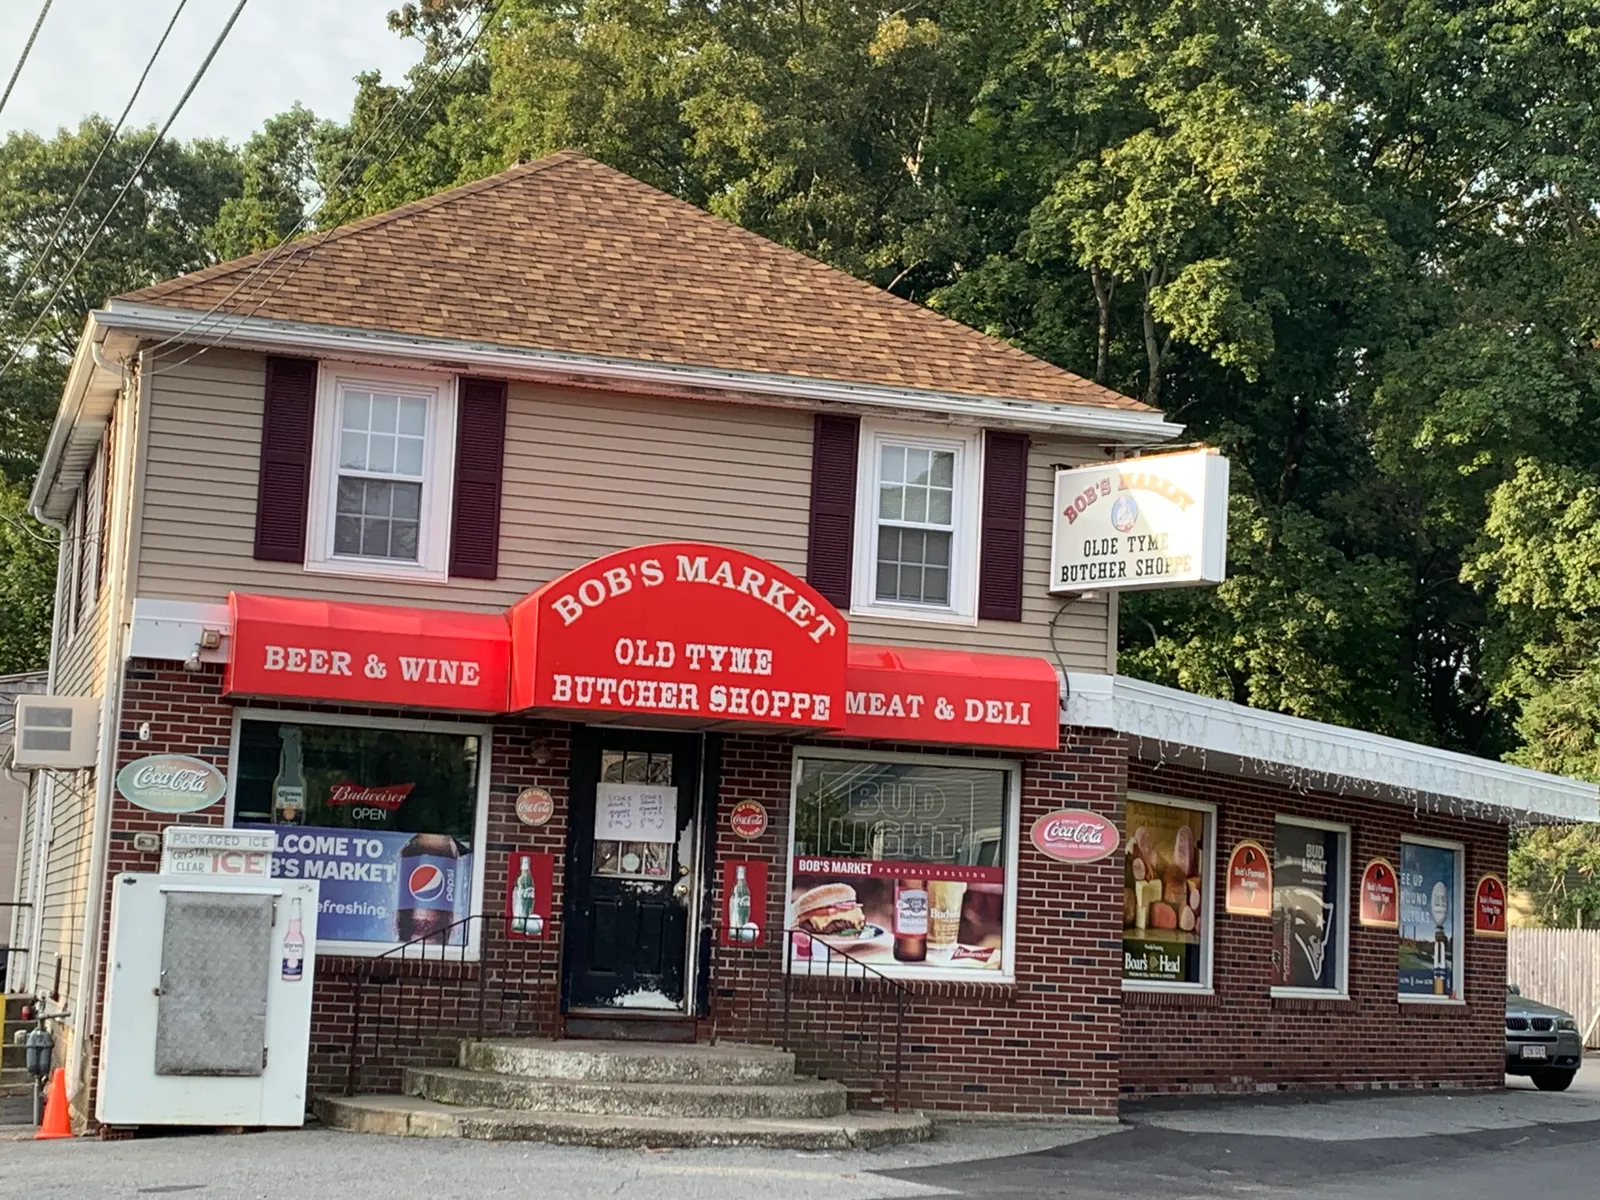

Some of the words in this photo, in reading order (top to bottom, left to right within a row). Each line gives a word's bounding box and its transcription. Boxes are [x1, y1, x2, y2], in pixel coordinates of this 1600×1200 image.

[1063, 477, 1111, 525] BOB'S
[1083, 537, 1118, 557] OLDE
[1127, 532, 1169, 553] TYME
[1061, 560, 1127, 583] BUTCHER
[1135, 554, 1192, 576] SHOPPE
[551, 559, 664, 626] BOB'S
[676, 555, 836, 644] MARKET
[263, 645, 353, 678] BEER
[364, 653, 387, 680] &
[399, 656, 481, 687] WINE
[614, 638, 676, 668] OLD
[685, 643, 773, 676] TYME
[552, 674, 700, 710] BUTCHER
[708, 685, 831, 721] SHOPPE
[845, 690, 924, 718] MEAT
[934, 696, 955, 721] &
[964, 698, 1031, 726] DELI
[330, 785, 407, 803] Budweiser
[848, 780, 946, 819] BUD
[352, 807, 387, 821] OPEN
[172, 834, 240, 847] PACKAGED
[249, 836, 269, 848] ICE
[352, 838, 383, 859] TO
[828, 817, 963, 859] LIGHT
[1305, 843, 1324, 858] BUD
[172, 848, 211, 861] CRYSTAL
[211, 852, 265, 874] ICE
[176, 861, 205, 873] CLEAR
[304, 860, 396, 883] MARKET
[799, 860, 830, 873] BOB'S
[831, 862, 873, 875] MARKET
[879, 867, 931, 876] PROUDLY
[936, 870, 987, 879] SELLING
[1301, 857, 1327, 875] LIGHT
[446, 868, 456, 902] pepsi
[1413, 874, 1424, 887] UP
[1124, 952, 1148, 971] Boar's
[1159, 955, 1180, 973] Head
